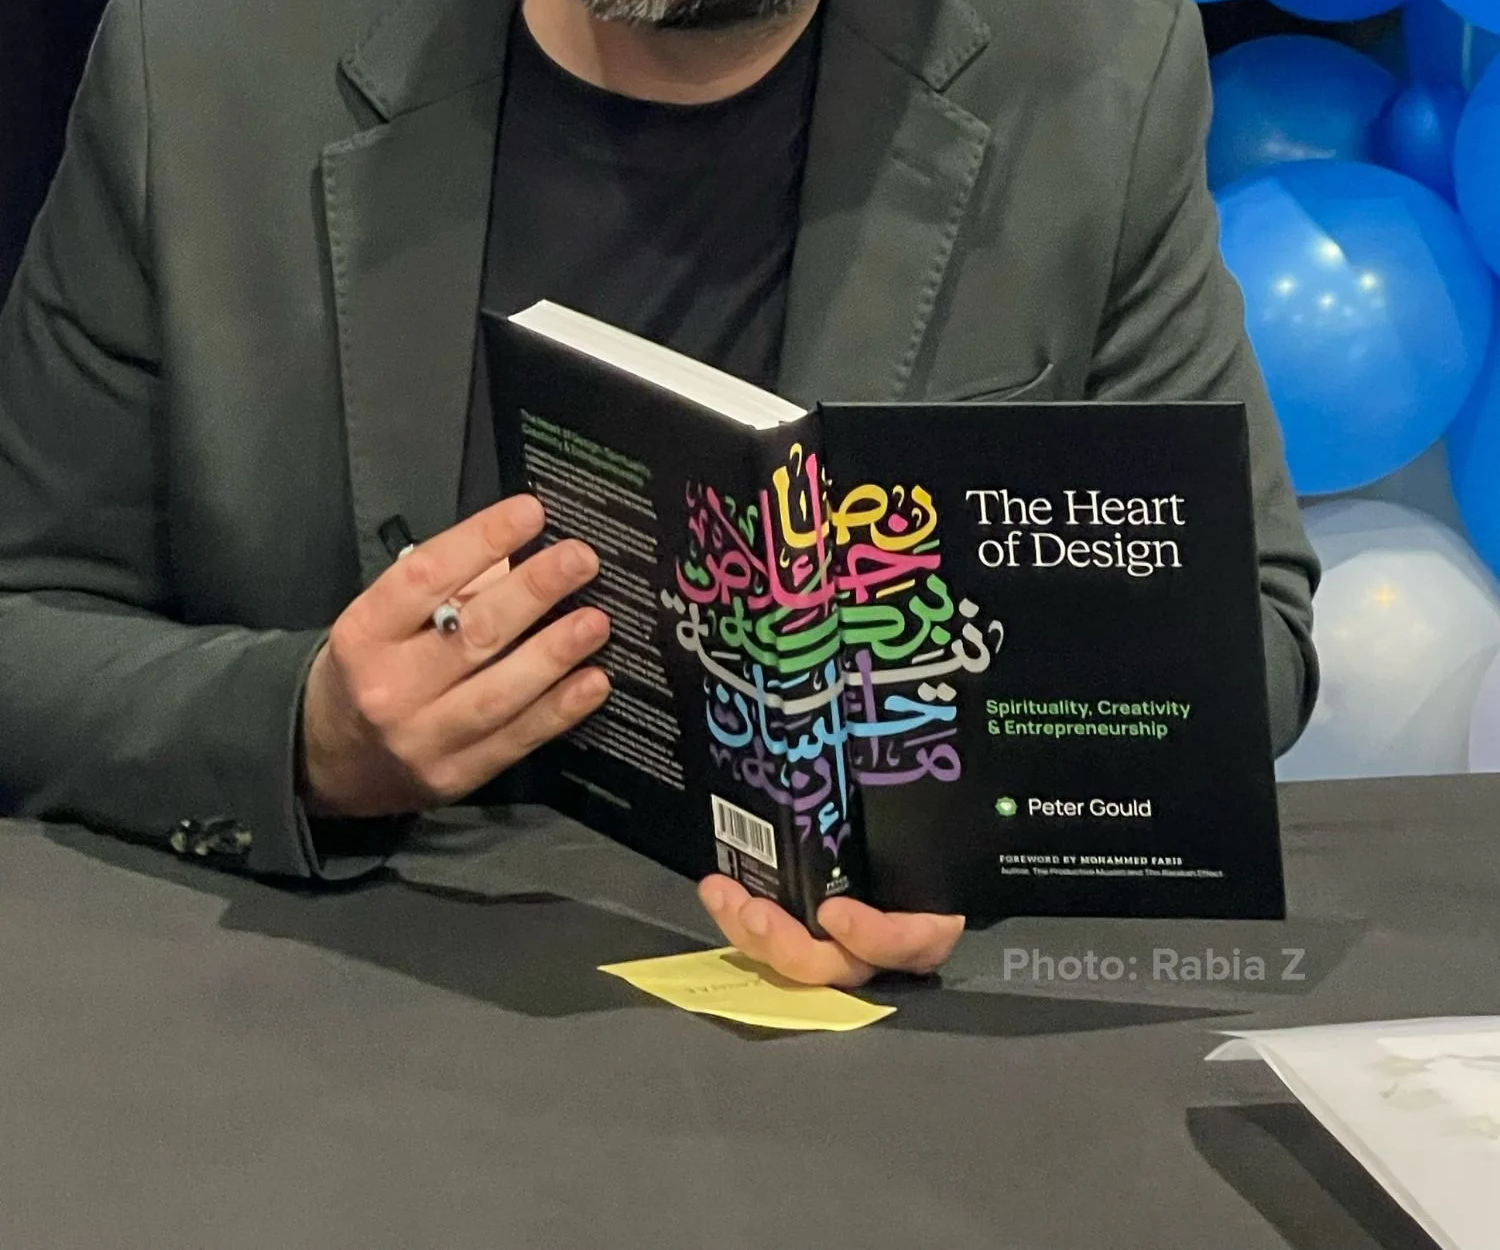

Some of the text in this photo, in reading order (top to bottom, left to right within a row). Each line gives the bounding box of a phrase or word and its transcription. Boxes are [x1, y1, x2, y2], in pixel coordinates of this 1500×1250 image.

[966, 489, 1186, 526] The Heart
[978, 530, 1183, 577] of Design
[986, 700, 1190, 719] Spirituality, Creativity
[988, 720, 1168, 739] & Entrepreneurship
[1028, 798, 1152, 817] Peter Gould
[1000, 854, 1060, 865] FOREWORD
[1063, 855, 1076, 865] BY
[1080, 855, 1148, 866] MOHAMMED
